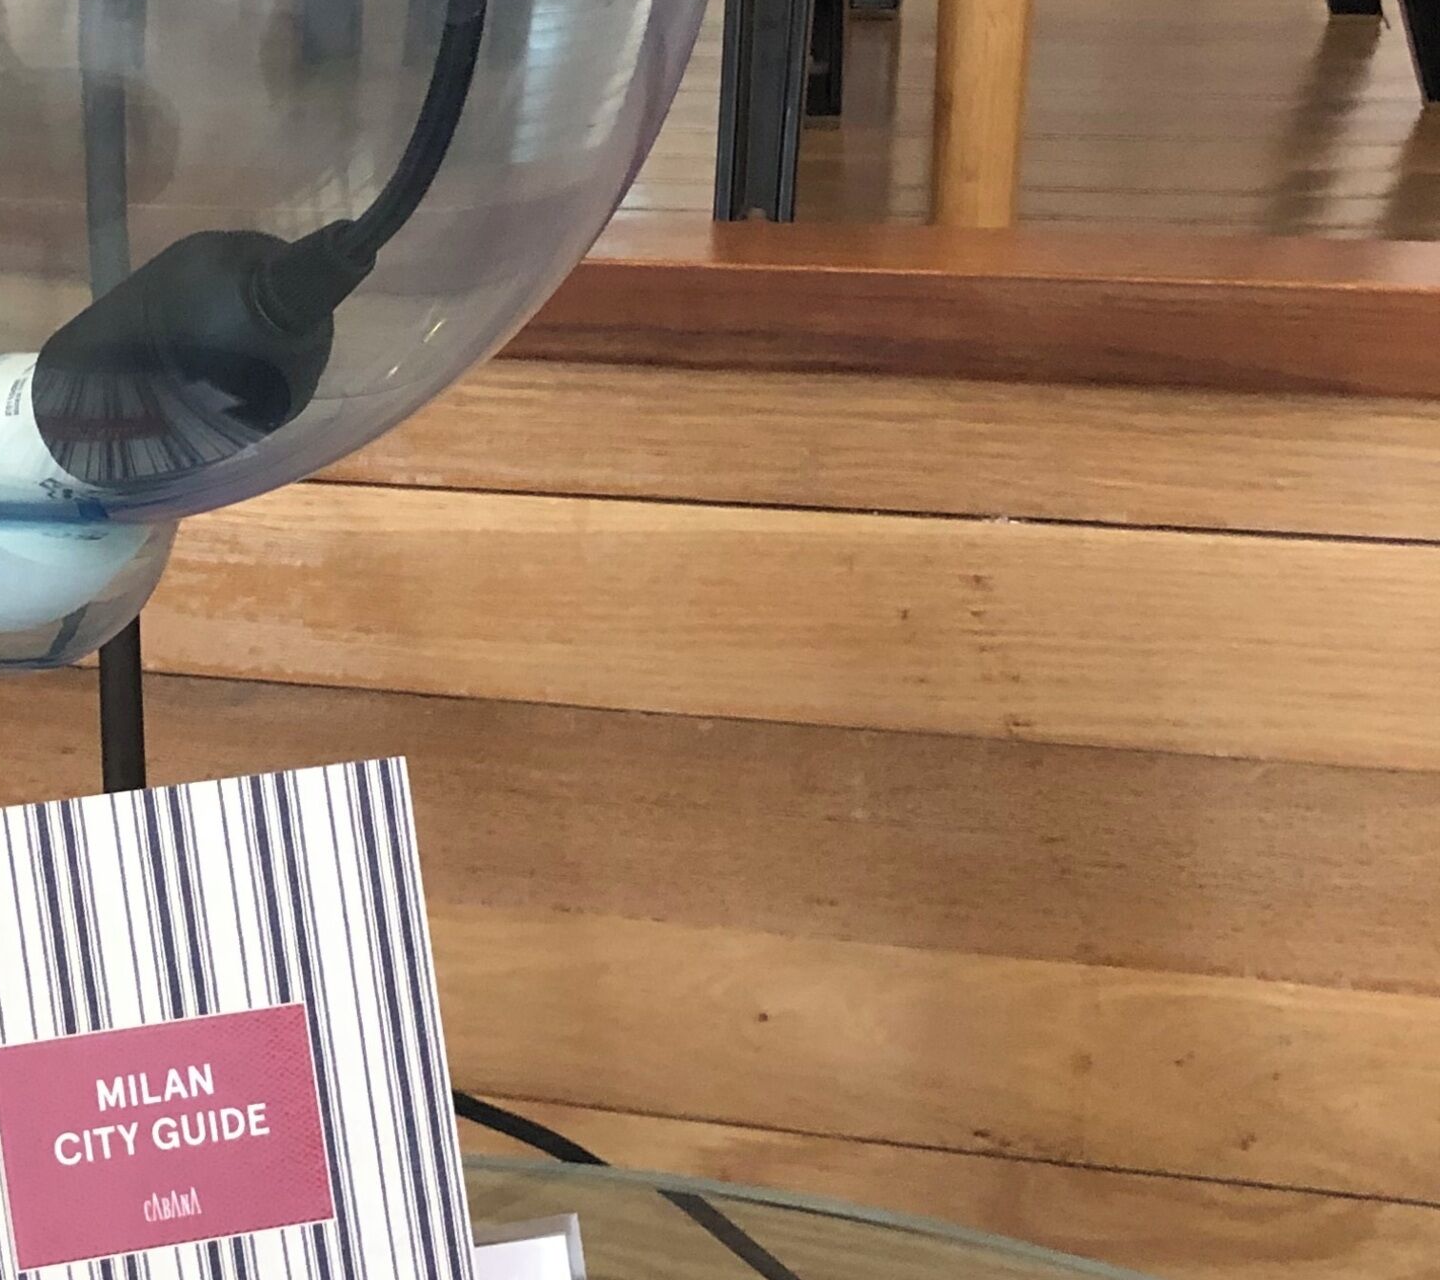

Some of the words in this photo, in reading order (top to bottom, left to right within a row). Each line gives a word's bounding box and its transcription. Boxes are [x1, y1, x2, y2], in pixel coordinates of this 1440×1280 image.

[95, 1063, 215, 1111] MILAN
[54, 1122, 139, 1165] CITY
[151, 1103, 270, 1150] GUIDE
[143, 1186, 202, 1222] CABANA
